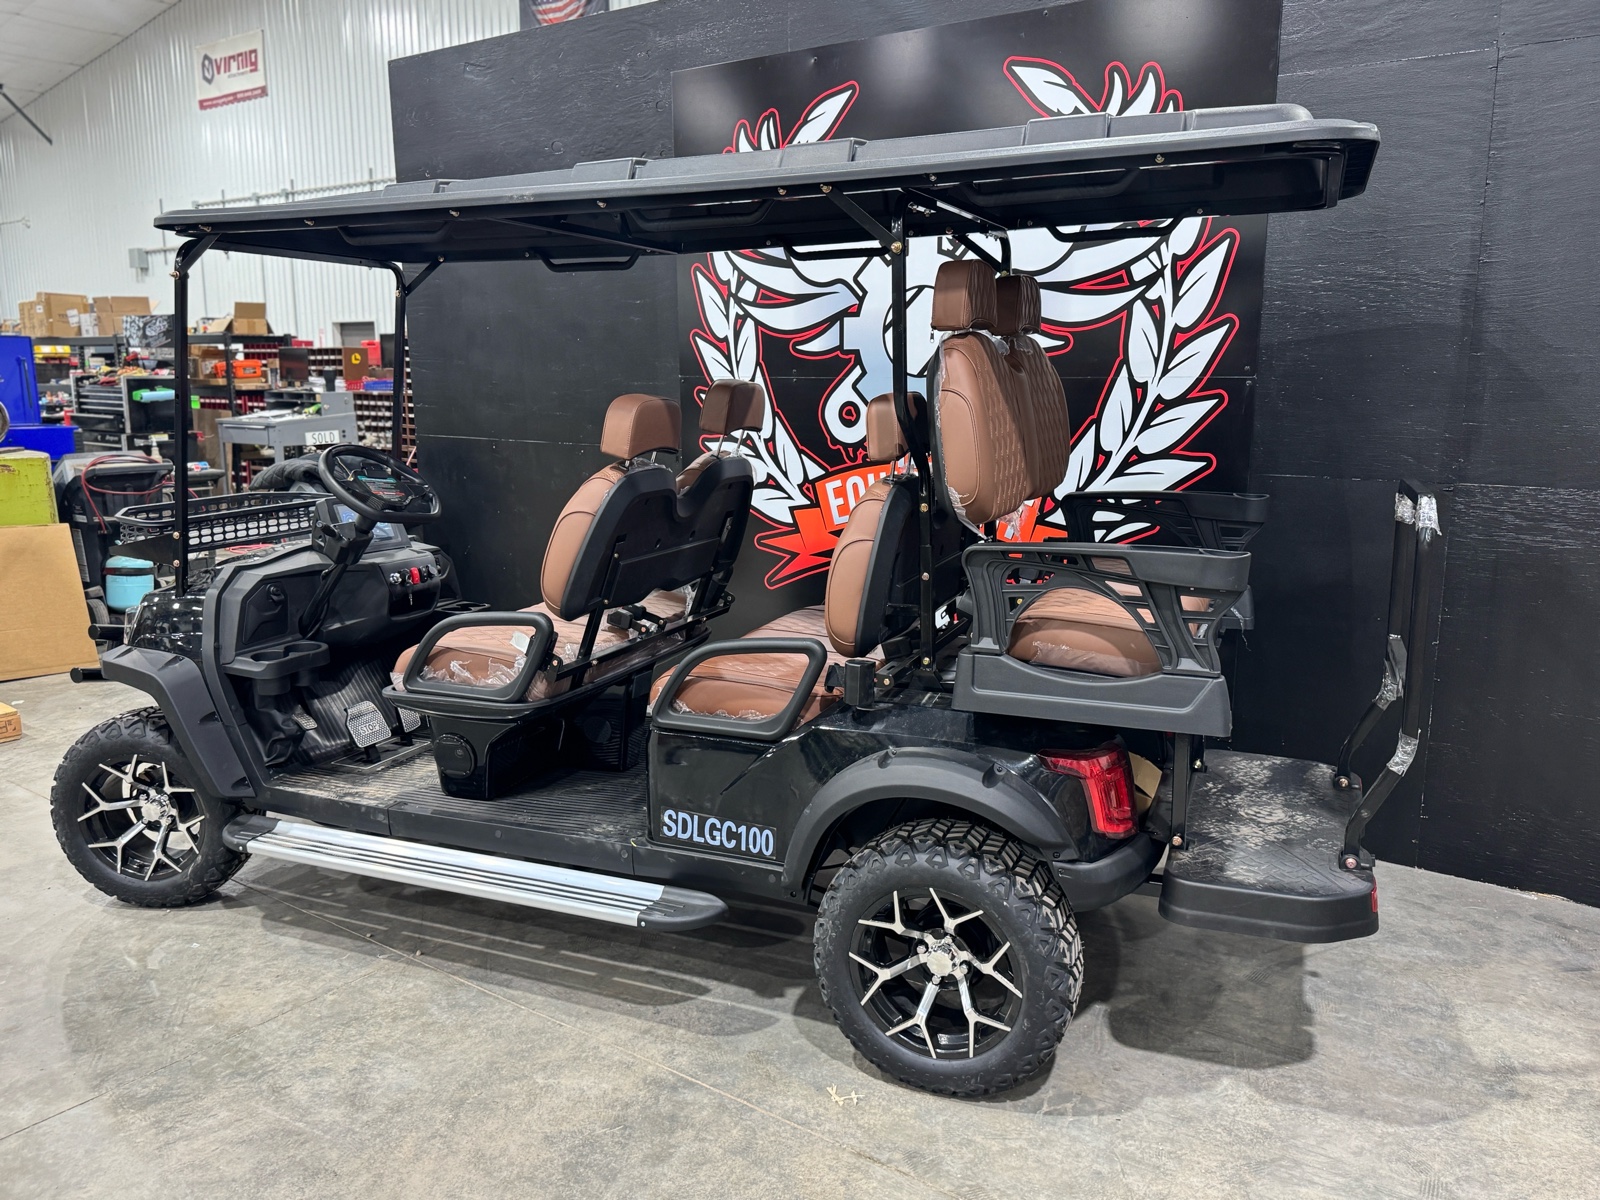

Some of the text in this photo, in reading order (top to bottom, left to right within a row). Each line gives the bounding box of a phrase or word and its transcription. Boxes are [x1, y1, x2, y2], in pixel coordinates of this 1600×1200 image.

[311, 430, 336, 445] SOLD
[359, 721, 378, 735] STOP
[662, 808, 774, 857] SDLGC100
